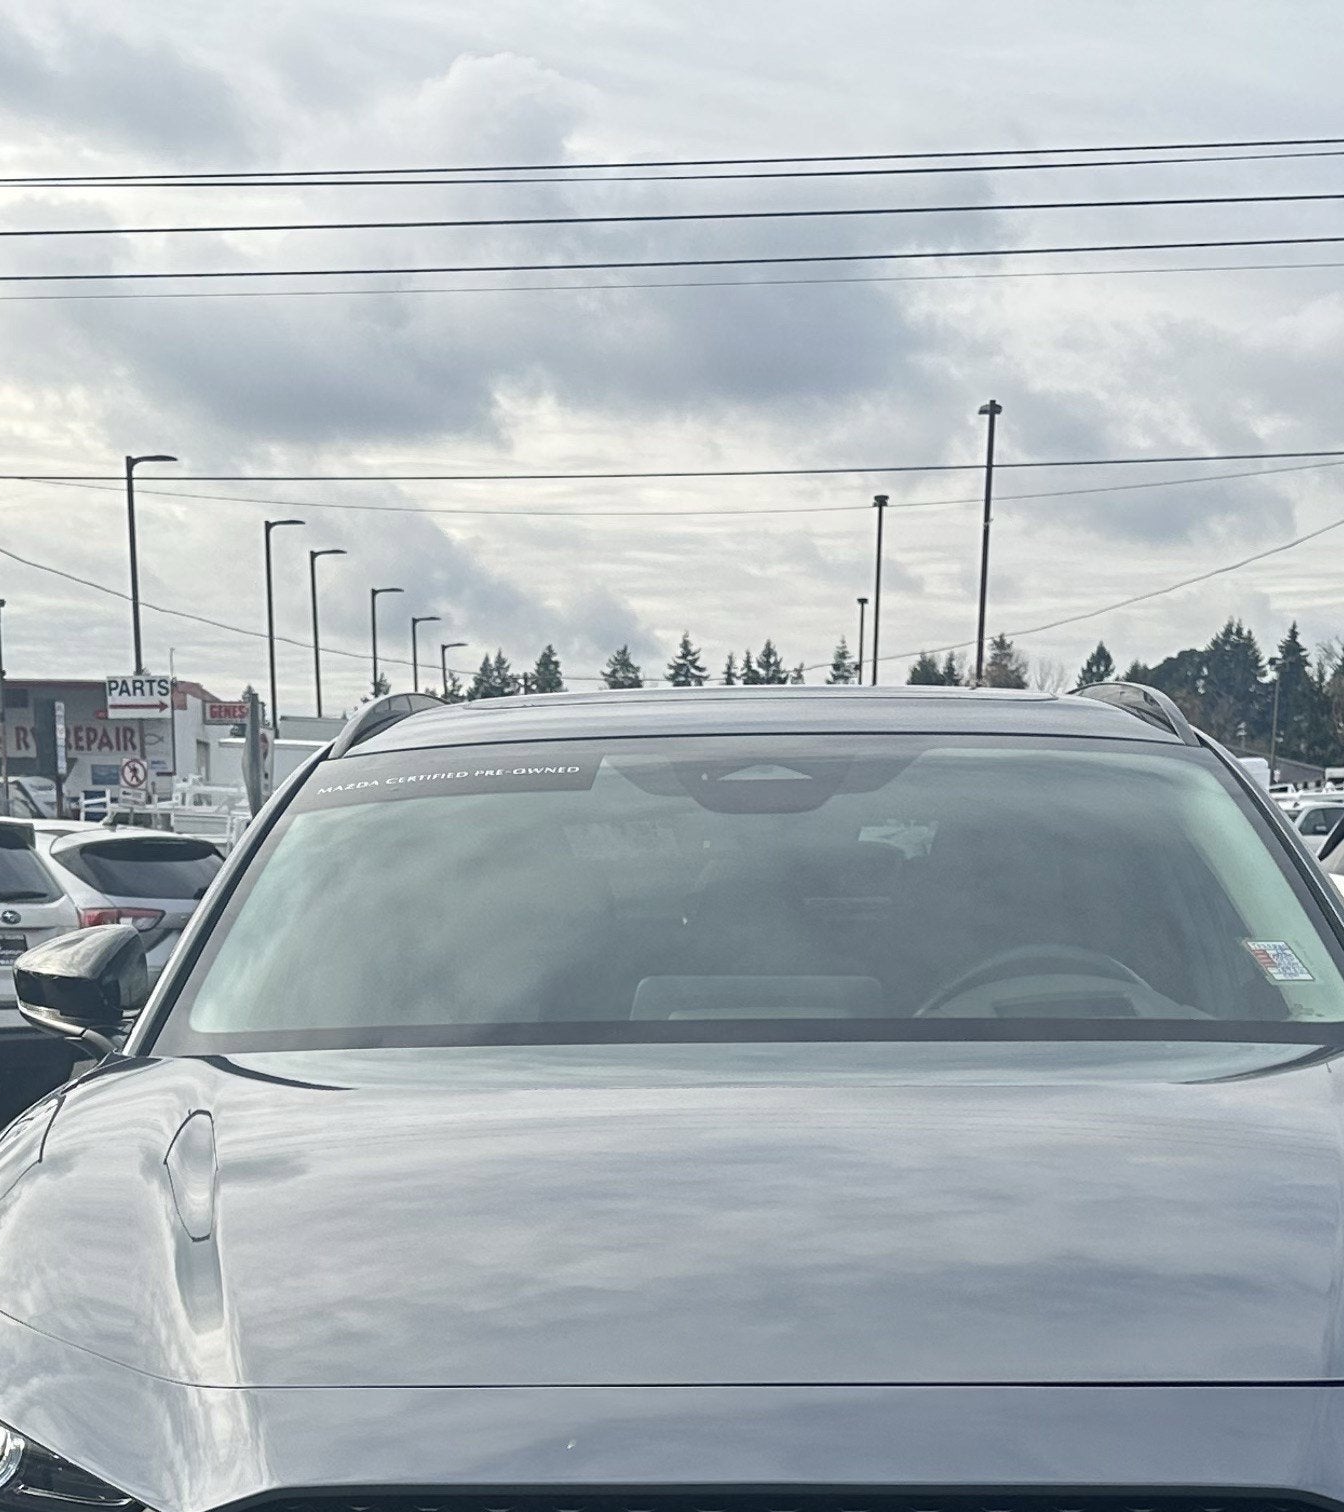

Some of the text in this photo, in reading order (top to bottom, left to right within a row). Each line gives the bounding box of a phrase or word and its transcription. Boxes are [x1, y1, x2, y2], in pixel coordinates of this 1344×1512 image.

[108, 678, 170, 697] PARTS
[316, 765, 581, 795] MAZDA CERTIFIED PRE-OWNED
